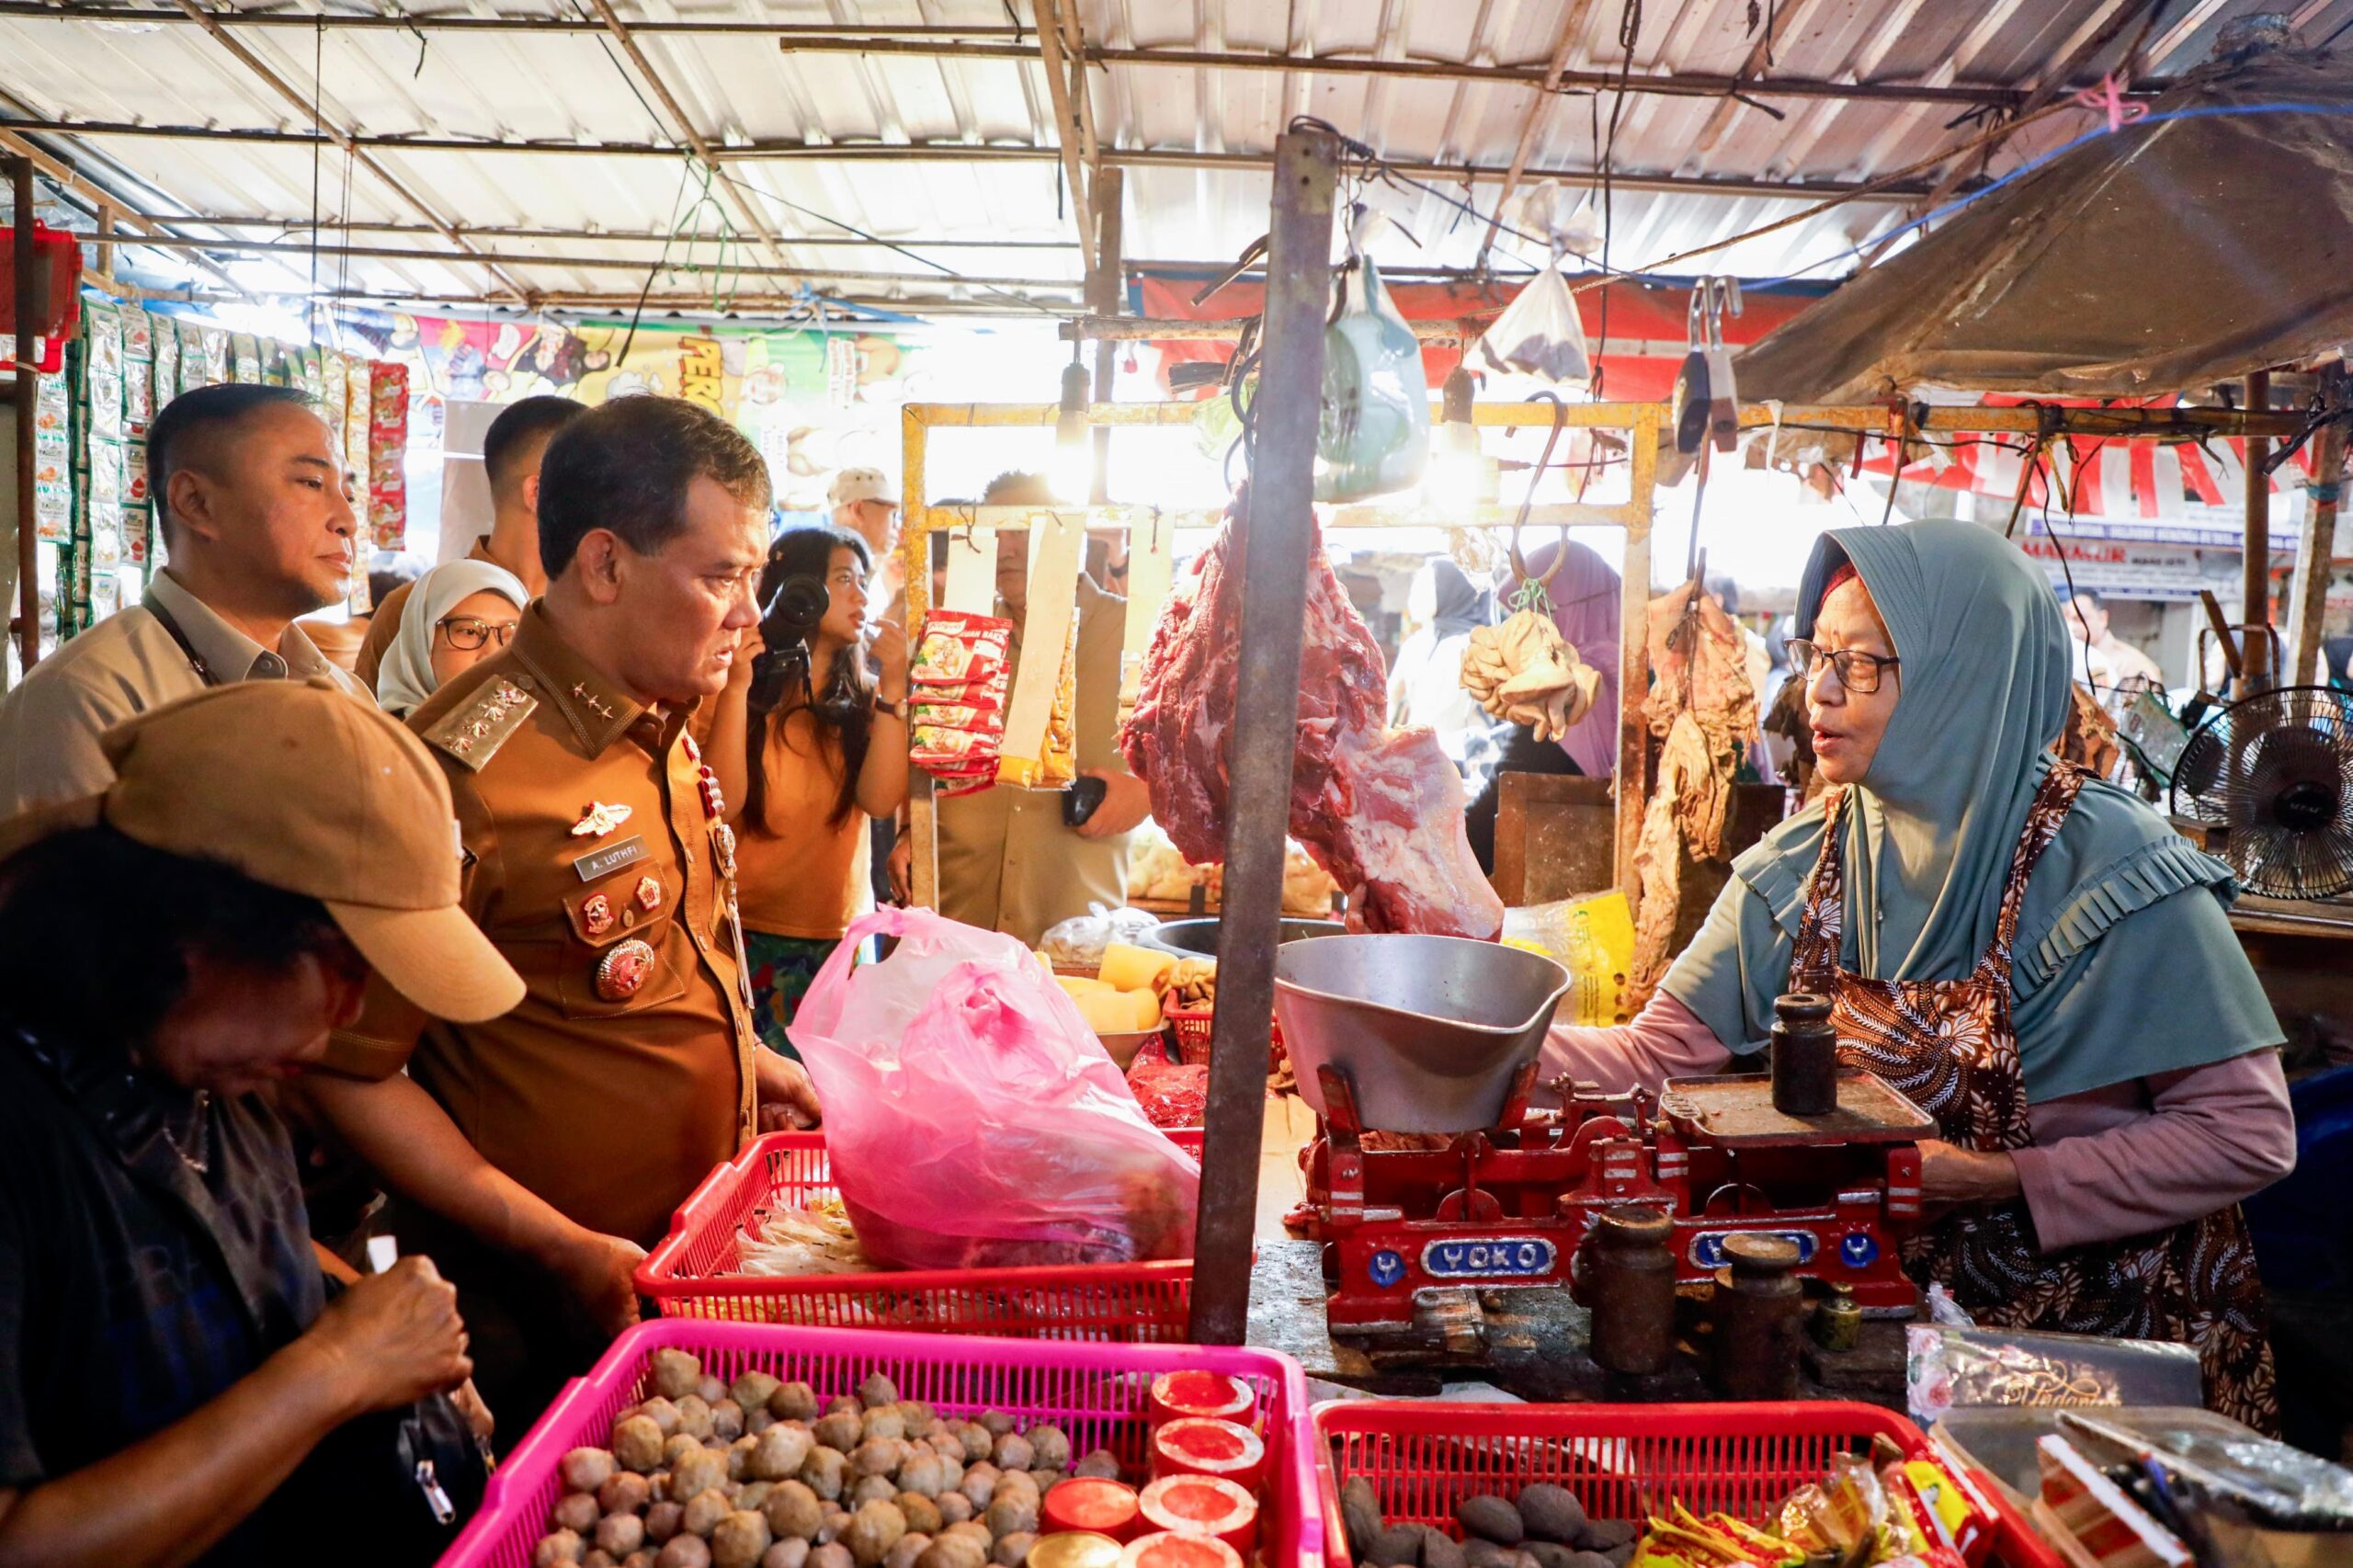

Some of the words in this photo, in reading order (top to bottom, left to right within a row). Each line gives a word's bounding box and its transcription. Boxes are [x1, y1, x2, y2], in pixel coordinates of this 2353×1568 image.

[591, 860, 603, 871] A.
[605, 845, 638, 865] LUTHFI
[1377, 1256, 1397, 1281] Y
[1443, 1244, 1537, 1270] YOKO
